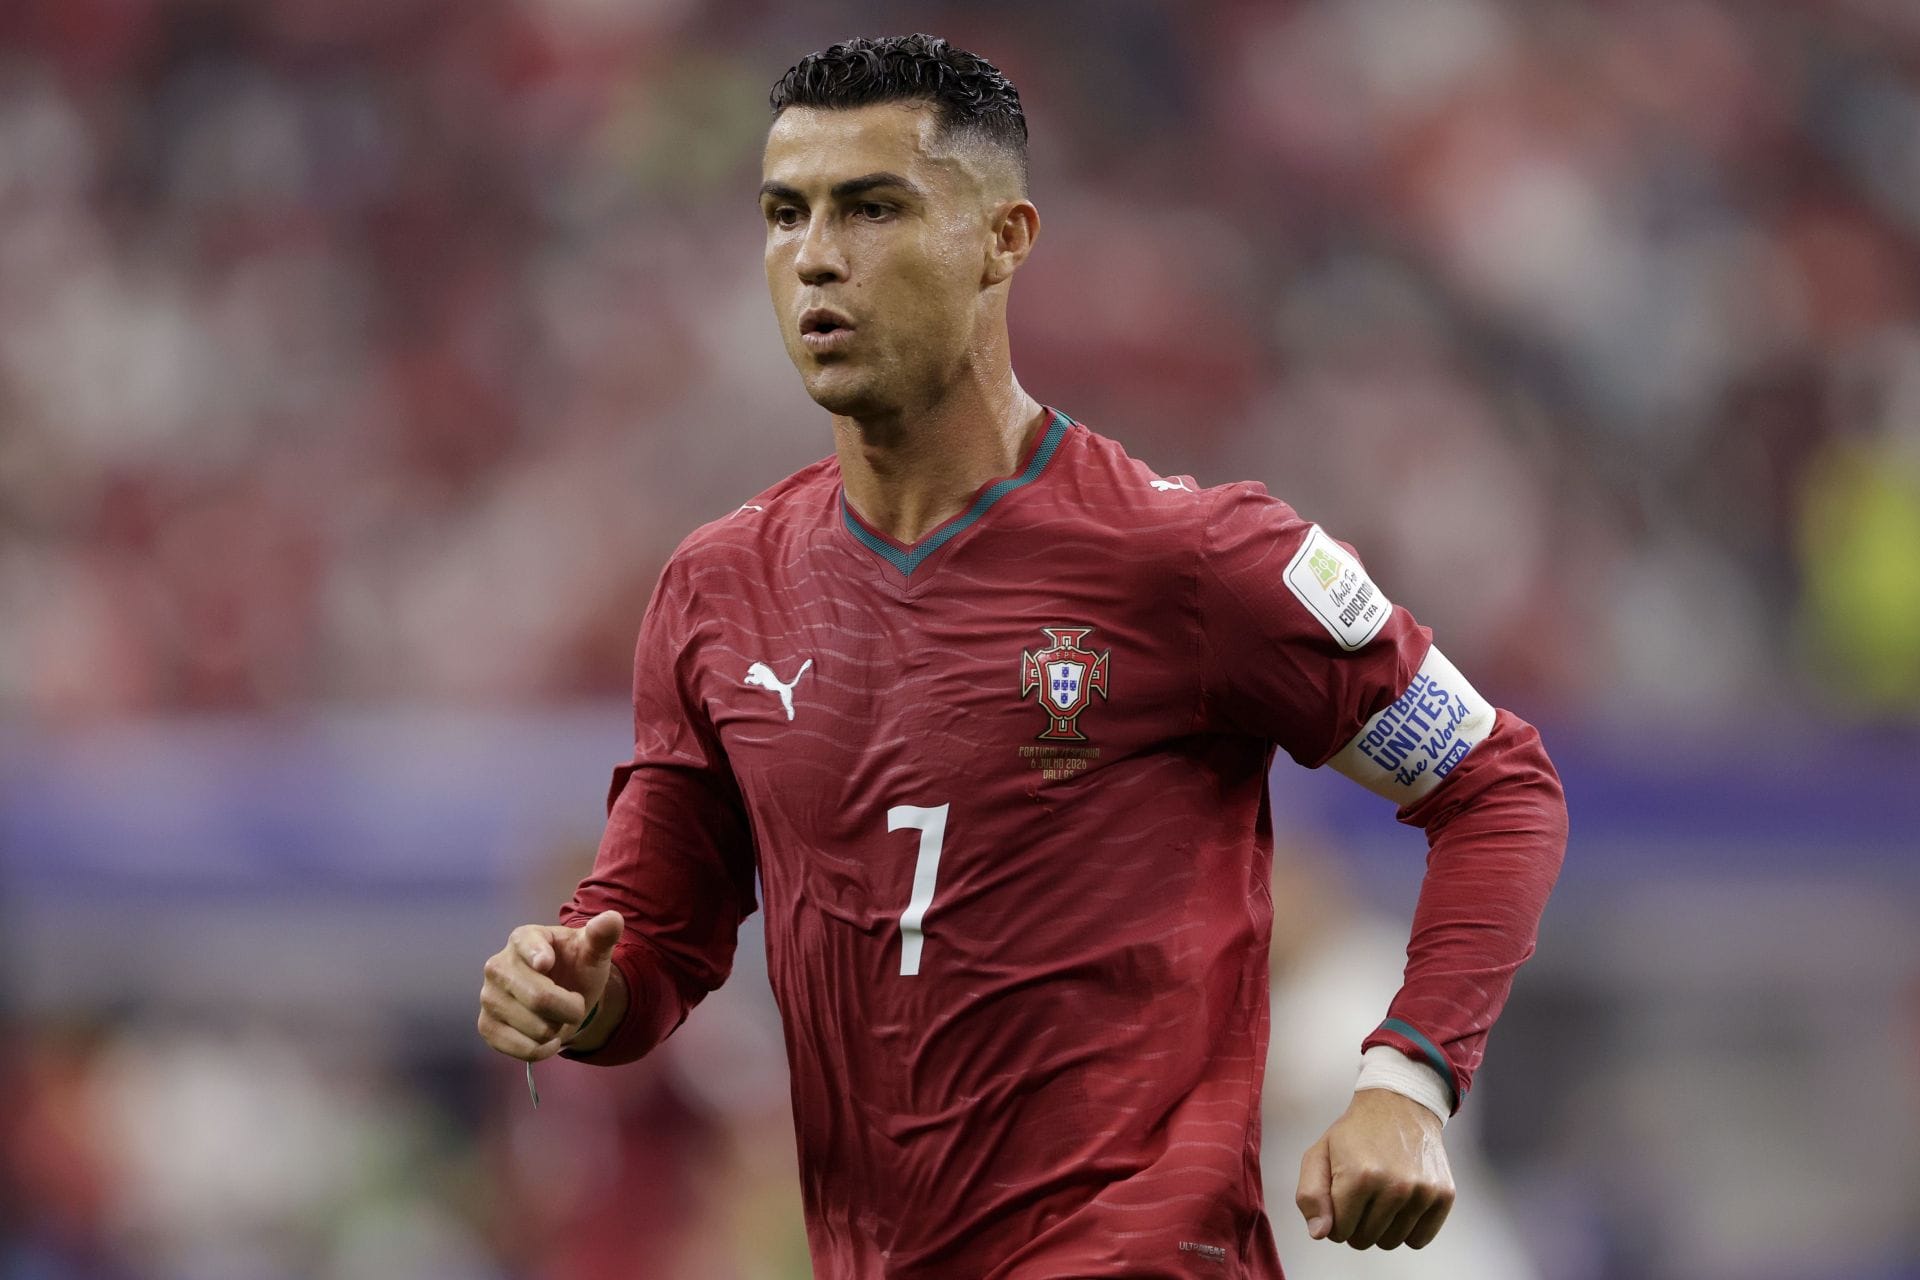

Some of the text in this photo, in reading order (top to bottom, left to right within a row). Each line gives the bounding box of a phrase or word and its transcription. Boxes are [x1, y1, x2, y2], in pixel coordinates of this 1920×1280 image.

[1329, 579, 1352, 608] Unite
[1363, 604, 1378, 623] FIFA
[1357, 672, 1430, 757] FOOTBALL
[1373, 681, 1449, 772] UNITES
[1394, 695, 1470, 787] the World
[1031, 759, 1036, 769] 6
[1066, 759, 1087, 770] 2026
[1437, 744, 1467, 776] FIFA
[887, 802, 950, 976] 7
